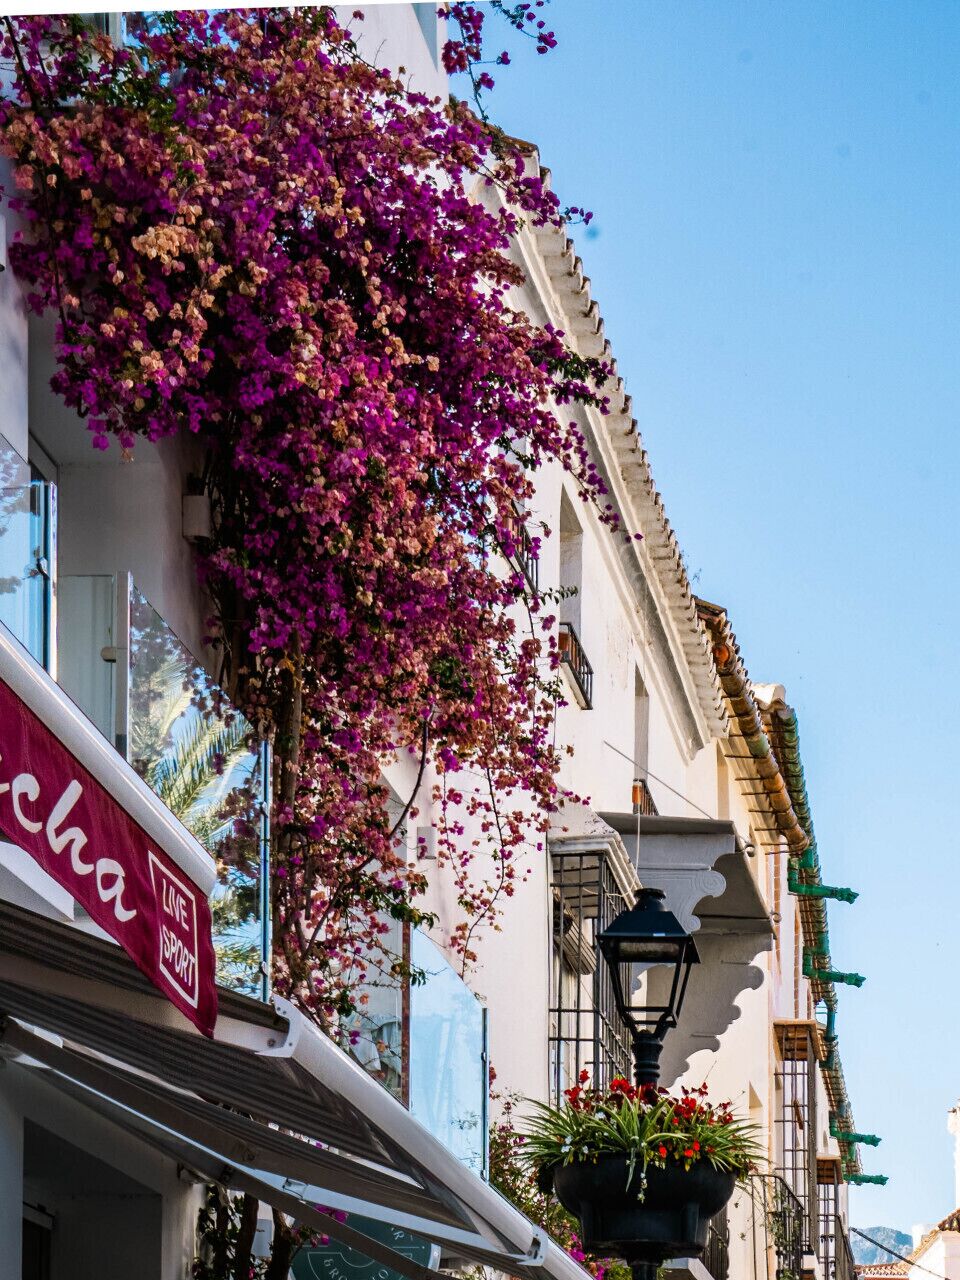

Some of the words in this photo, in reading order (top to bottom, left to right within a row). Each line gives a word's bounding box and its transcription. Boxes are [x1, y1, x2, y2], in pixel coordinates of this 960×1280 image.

[0, 753, 137, 922] cha
[162, 878, 189, 932] LIVE
[162, 924, 196, 987] SPORT
